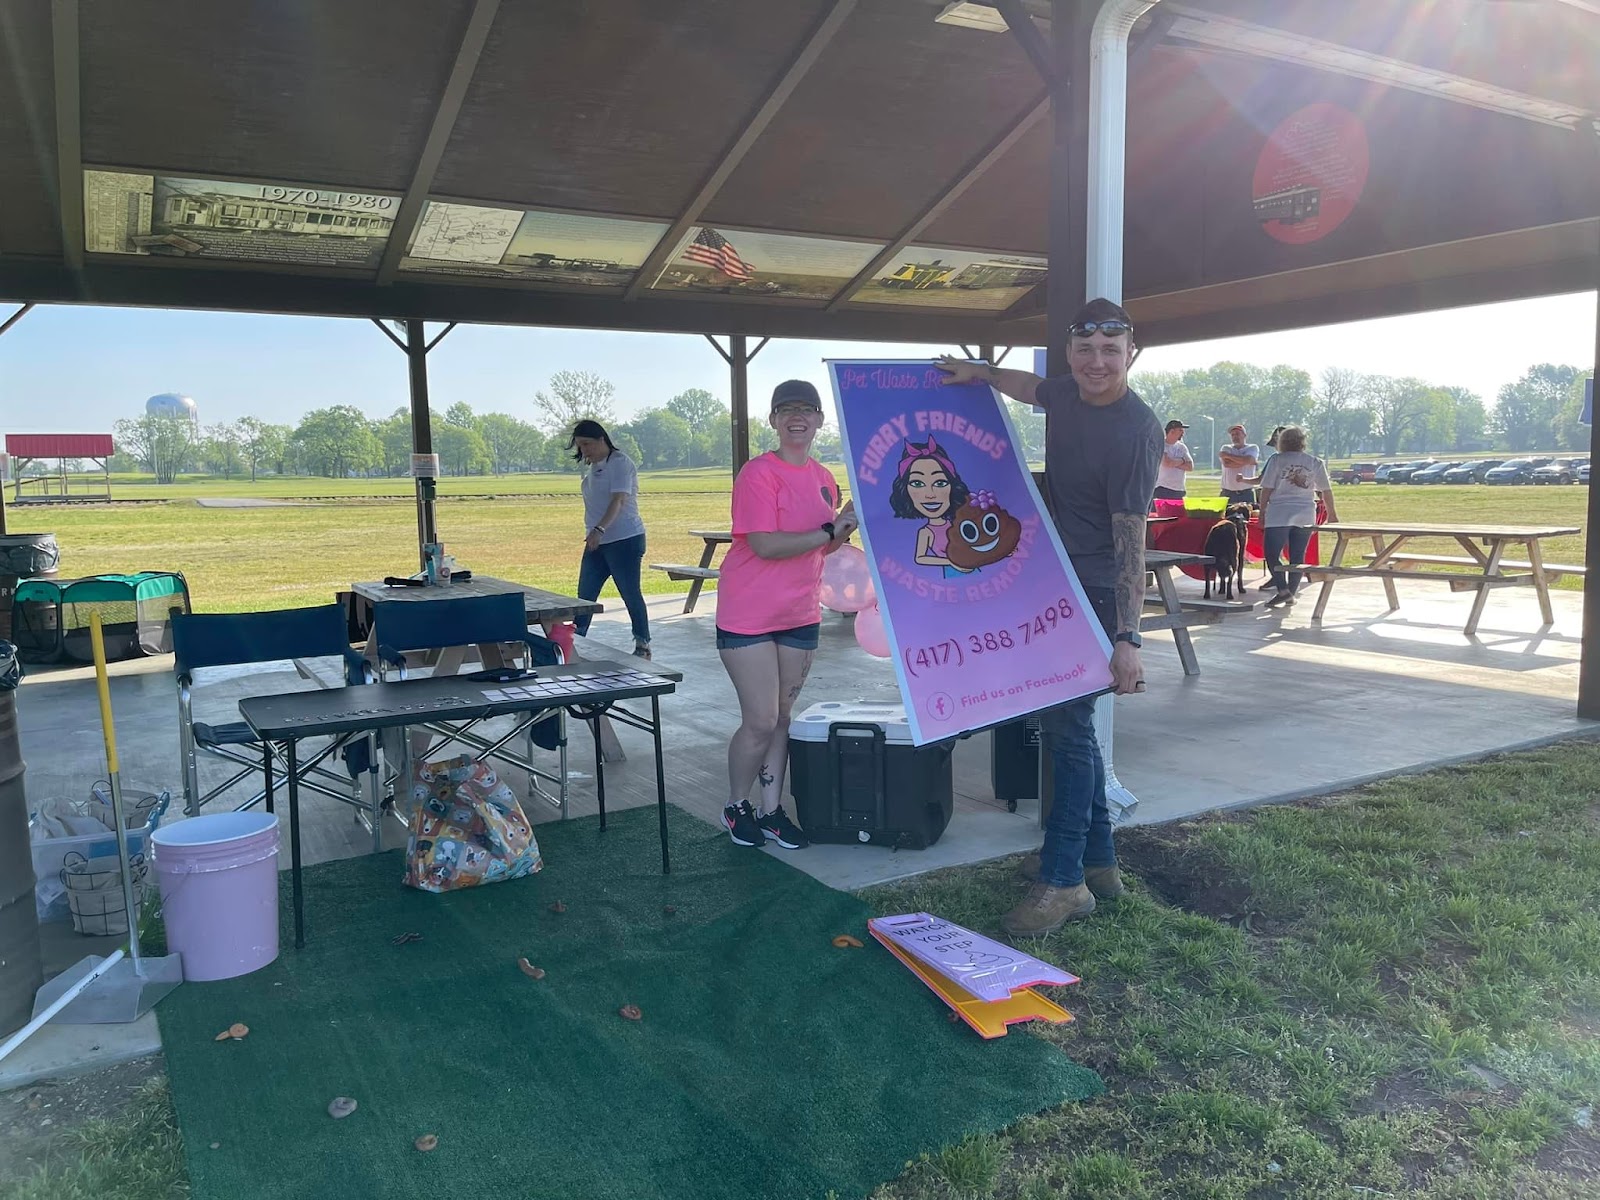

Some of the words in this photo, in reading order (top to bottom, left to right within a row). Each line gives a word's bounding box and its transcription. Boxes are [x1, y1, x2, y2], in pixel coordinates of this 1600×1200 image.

[260, 187, 392, 210] 1970-1980
[841, 369, 868, 390] Pet
[871, 369, 919, 389] Waste
[859, 414, 909, 486] FURRY
[914, 410, 1009, 460] FRIENDS
[879, 555, 959, 603] WASTE
[966, 512, 1041, 601] REMOVAL
[905, 638, 964, 678] (417)
[968, 629, 1015, 655] 388
[1017, 598, 1073, 645] 7498
[960, 690, 988, 708] Find
[990, 688, 1005, 699] us
[1008, 685, 1023, 696] on
[1025, 662, 1087, 691] Facebook
[893, 923, 949, 936] WATCH
[918, 931, 963, 943] YOUR
[935, 940, 973, 953] STEP
